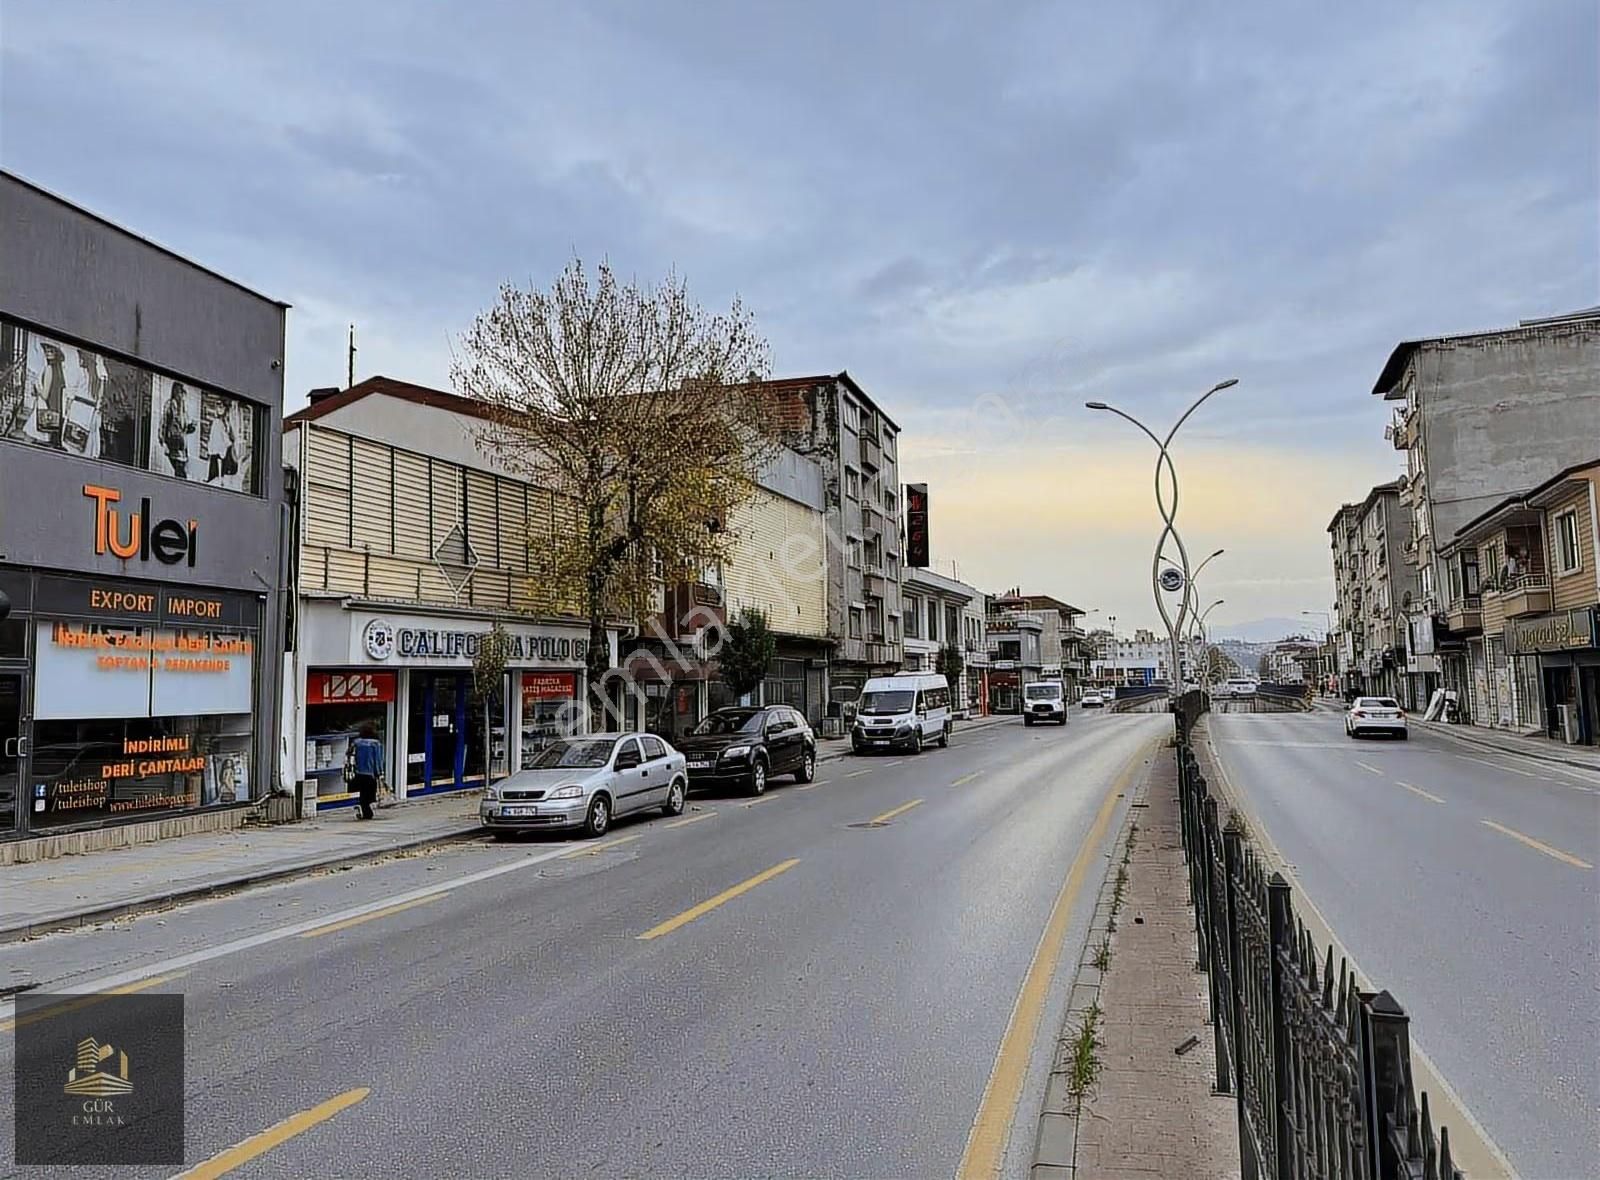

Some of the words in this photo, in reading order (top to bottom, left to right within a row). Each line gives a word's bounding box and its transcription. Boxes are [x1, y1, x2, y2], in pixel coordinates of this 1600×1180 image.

[83, 484, 198, 567] Tulei
[91, 590, 154, 612] EXPORT
[168, 597, 222, 618] IMPORT
[530, 637, 569, 657] POLO
[123, 734, 190, 754] İNDİRİMLİ
[102, 759, 135, 778] DERİ
[139, 757, 206, 778] ÇANTALAR
